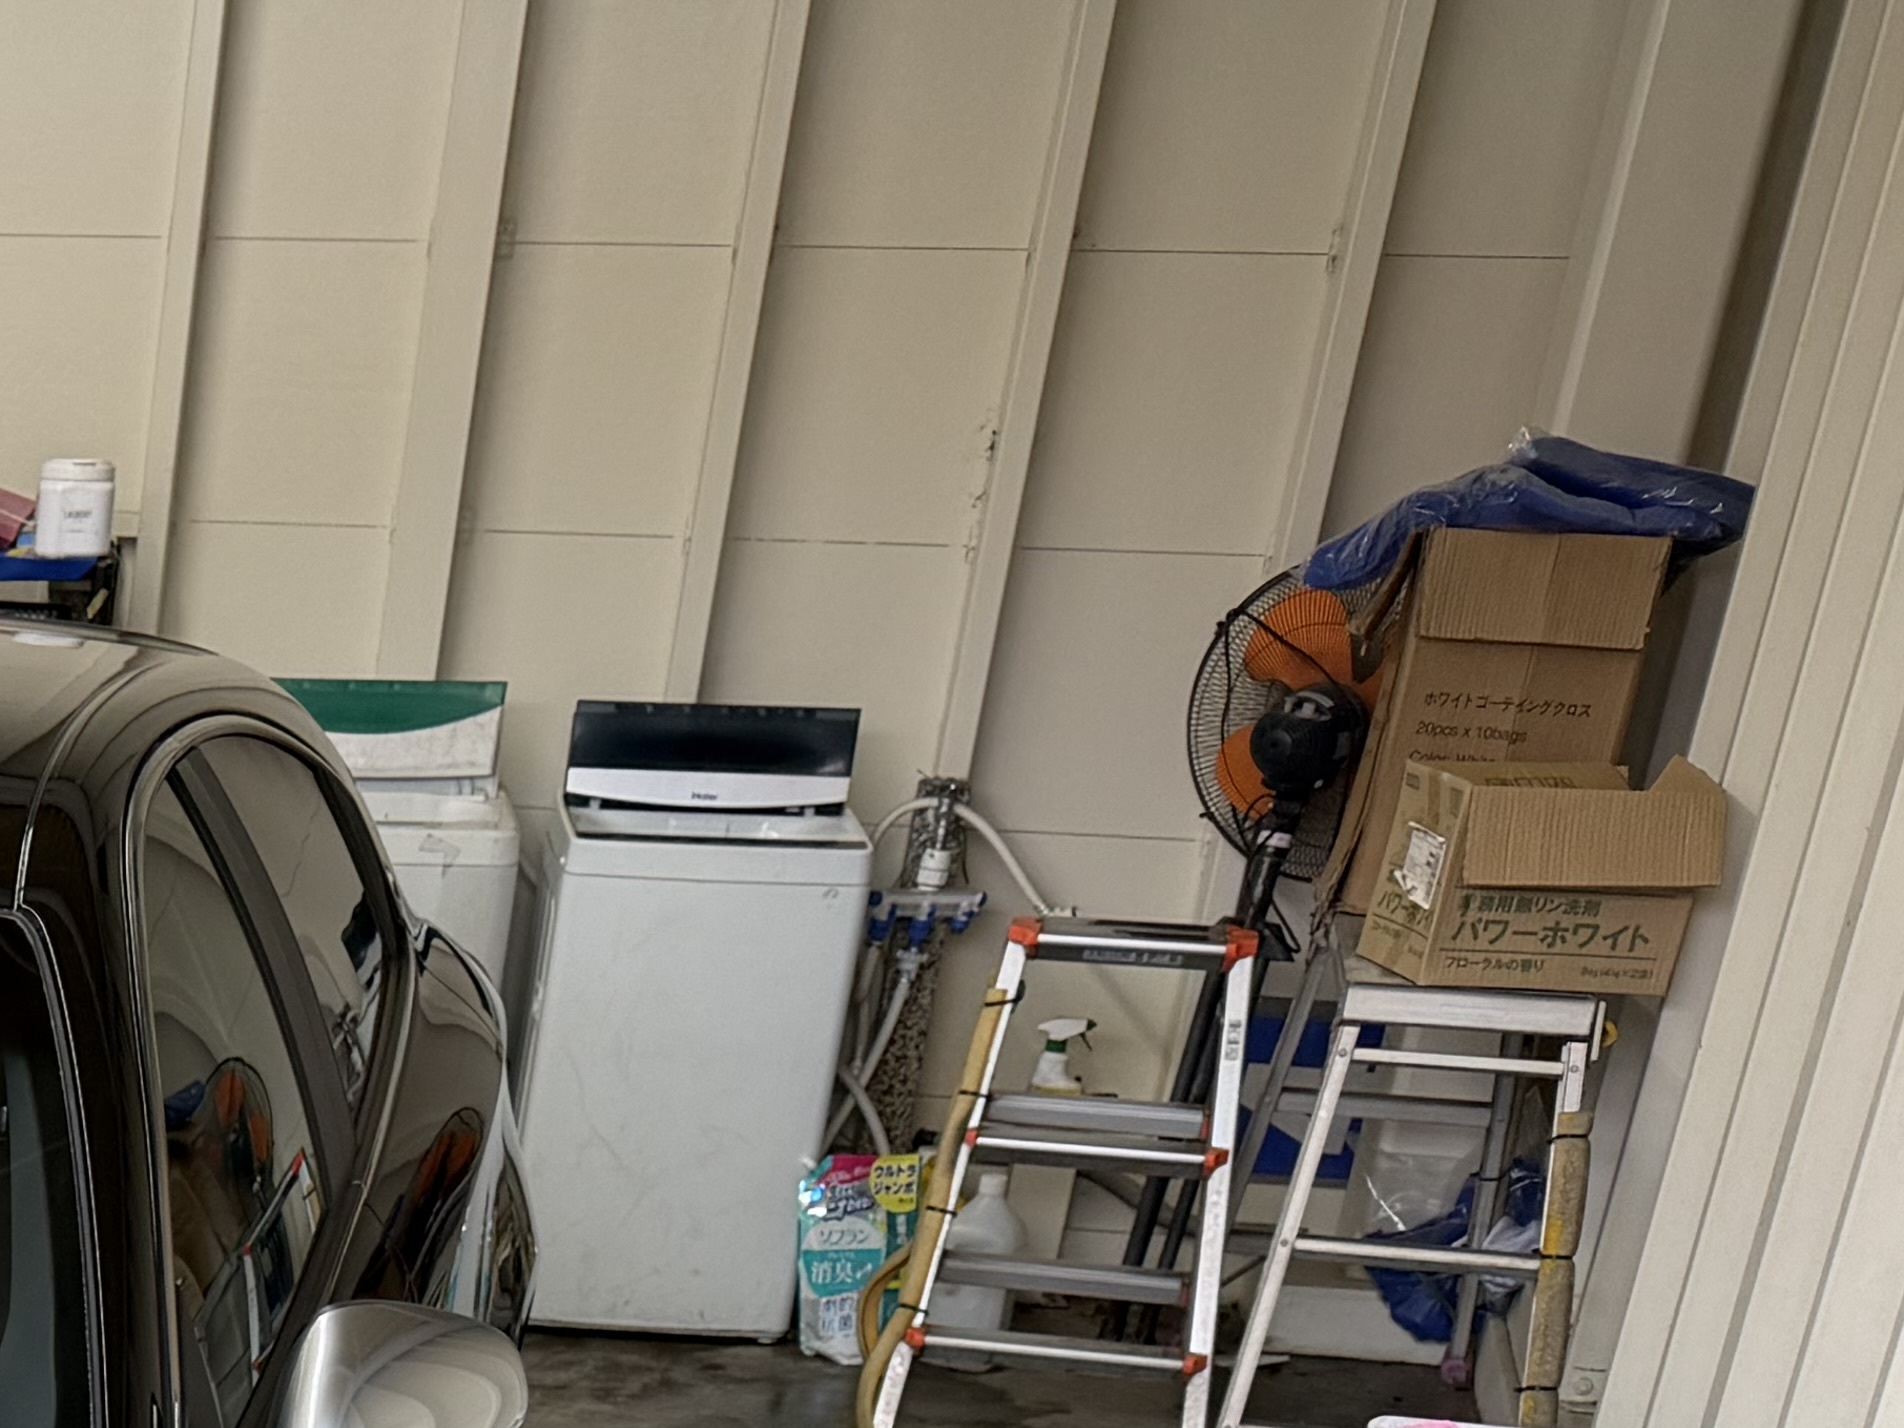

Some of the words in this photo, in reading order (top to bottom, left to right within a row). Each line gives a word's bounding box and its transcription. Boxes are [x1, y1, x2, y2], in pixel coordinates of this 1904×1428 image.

[1416, 720, 1458, 737] 20pcs
[1477, 726, 1527, 745] 10bags
[1451, 918, 1651, 953] パワーホワイト
[873, 1163, 916, 1179] ウルトラ
[873, 1182, 916, 1197] ジャンボ
[819, 1229, 871, 1247] ソフラン
[810, 1260, 855, 1285] 消臭
